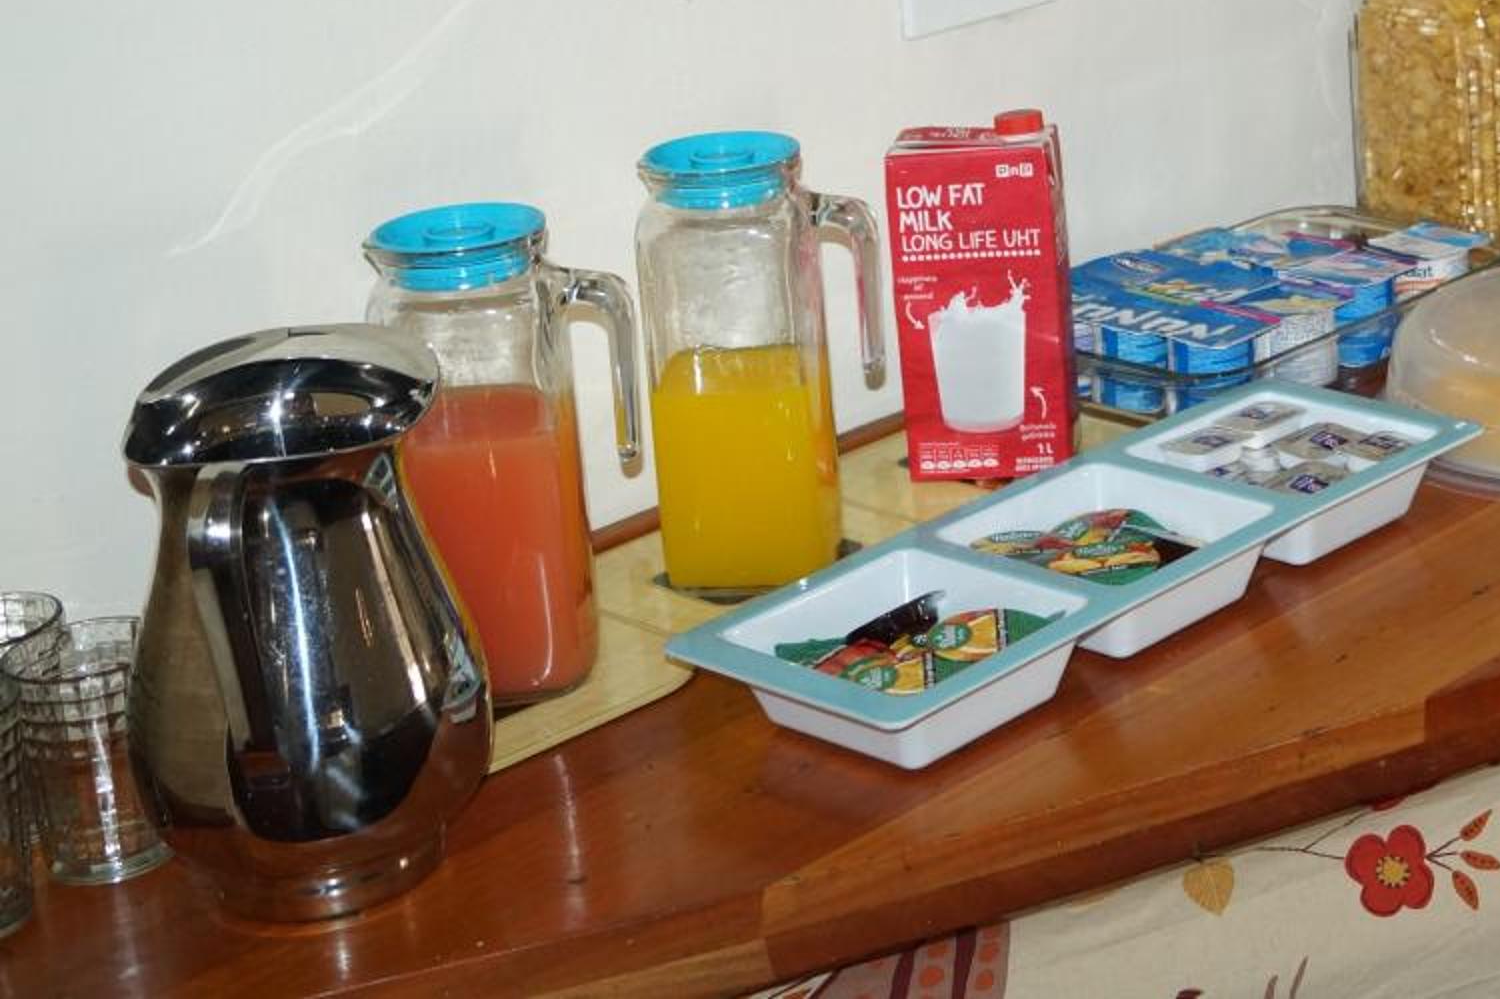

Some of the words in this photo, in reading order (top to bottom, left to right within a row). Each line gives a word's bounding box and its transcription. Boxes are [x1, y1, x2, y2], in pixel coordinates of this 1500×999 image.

[896, 185, 942, 209] LOW
[948, 183, 985, 206] FAT
[899, 209, 953, 234] MILK
[901, 234, 953, 253] LONG
[958, 230, 998, 250] LIFE
[1002, 228, 1041, 249] UHT
